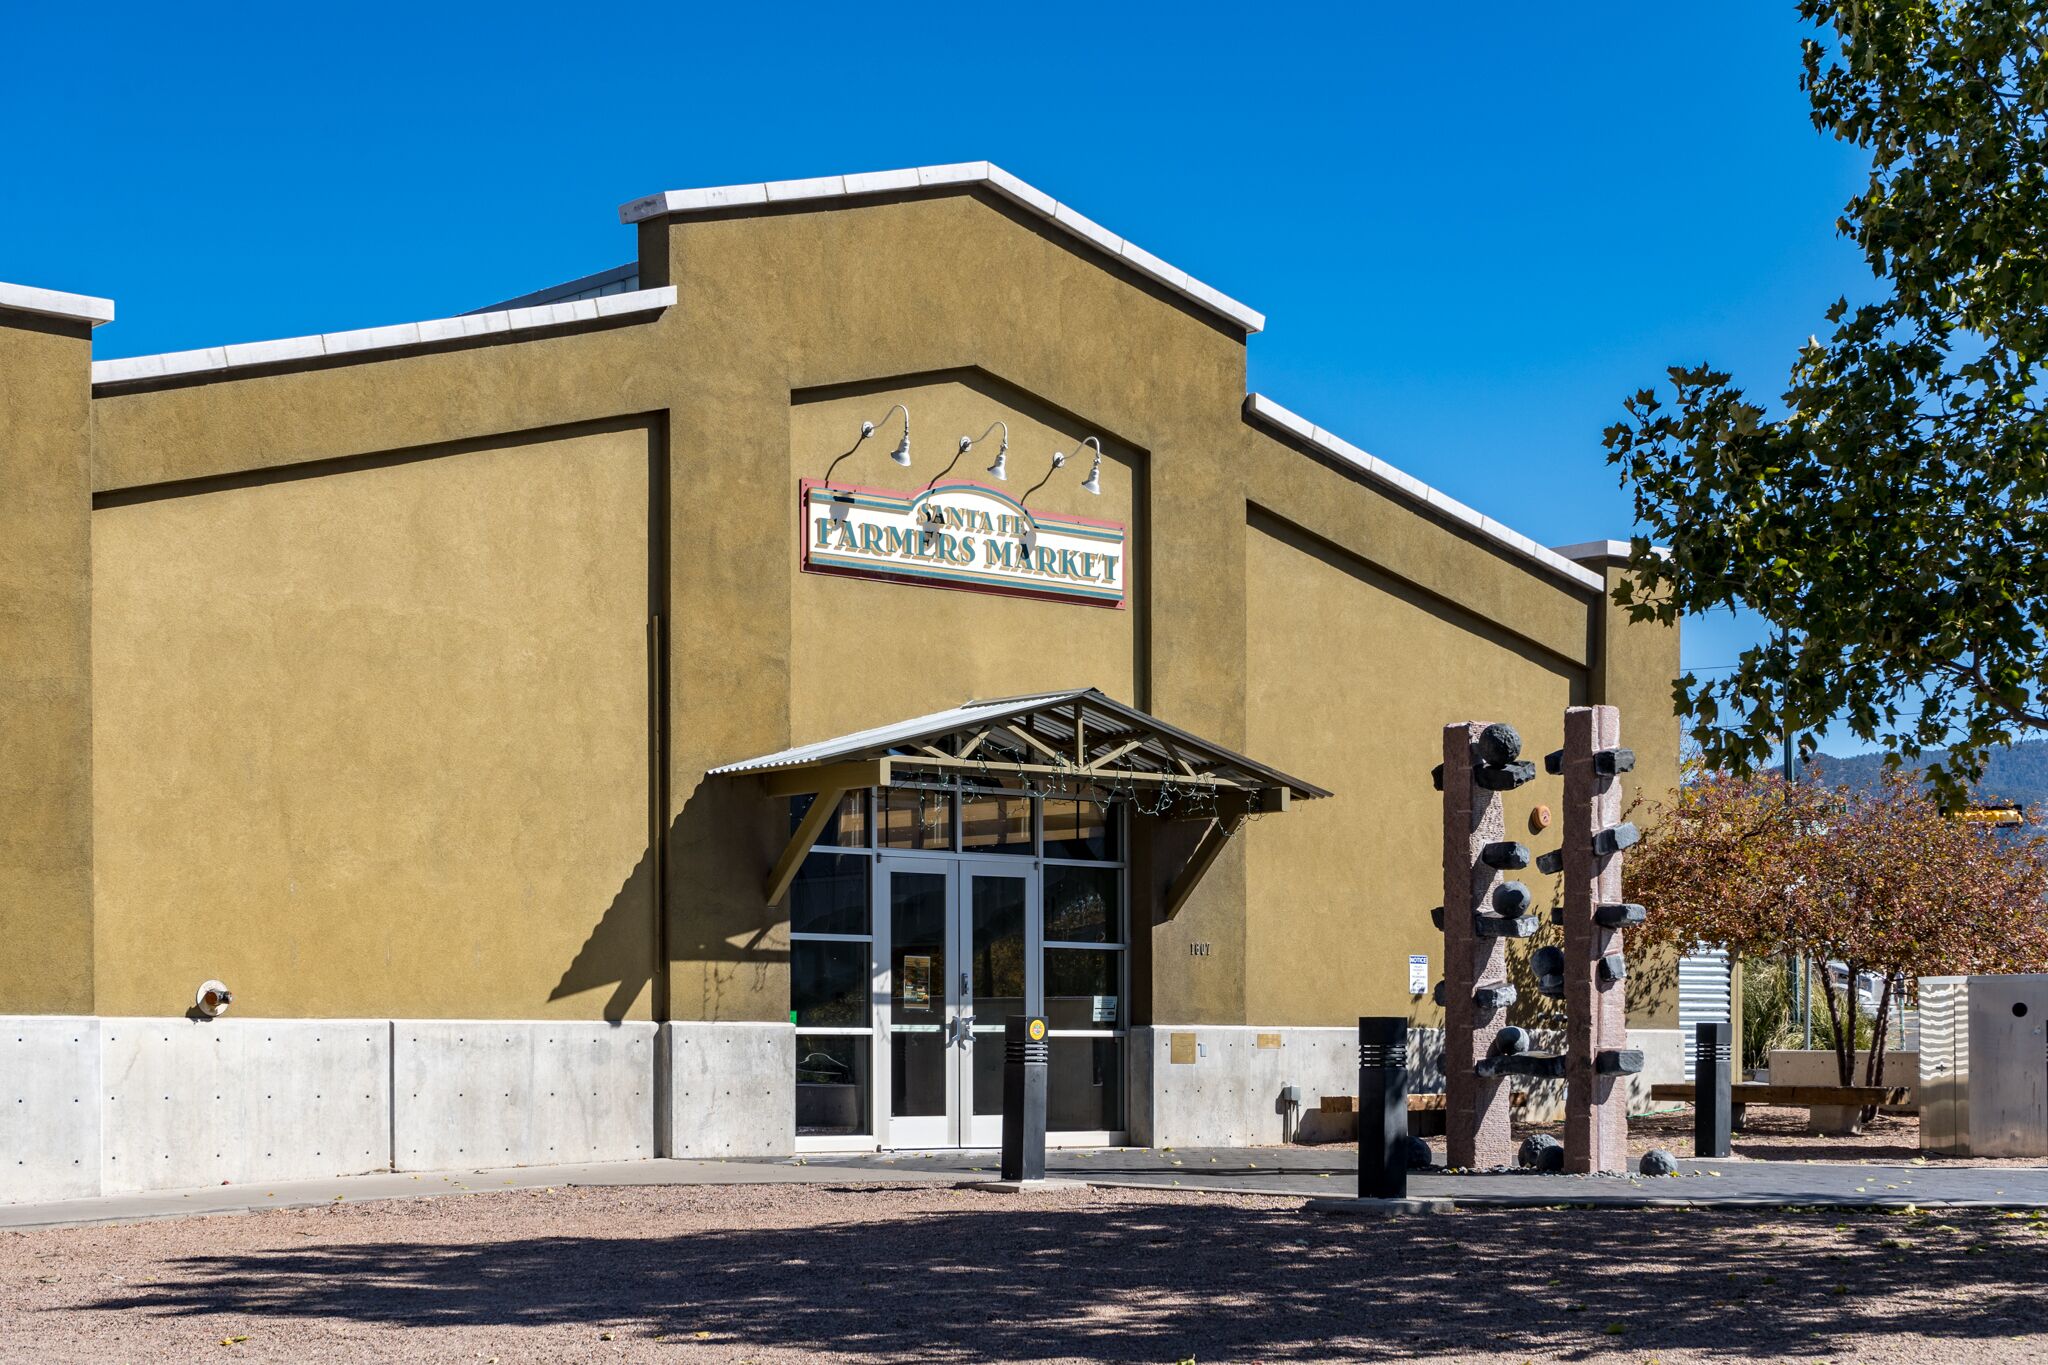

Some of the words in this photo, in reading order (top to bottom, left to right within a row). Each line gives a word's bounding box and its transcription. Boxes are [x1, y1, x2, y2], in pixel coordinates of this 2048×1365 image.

[916, 502, 994, 534] SANTA
[997, 513, 1028, 538] FE
[814, 517, 976, 566] FARMERS
[983, 538, 1119, 584] MARKET
